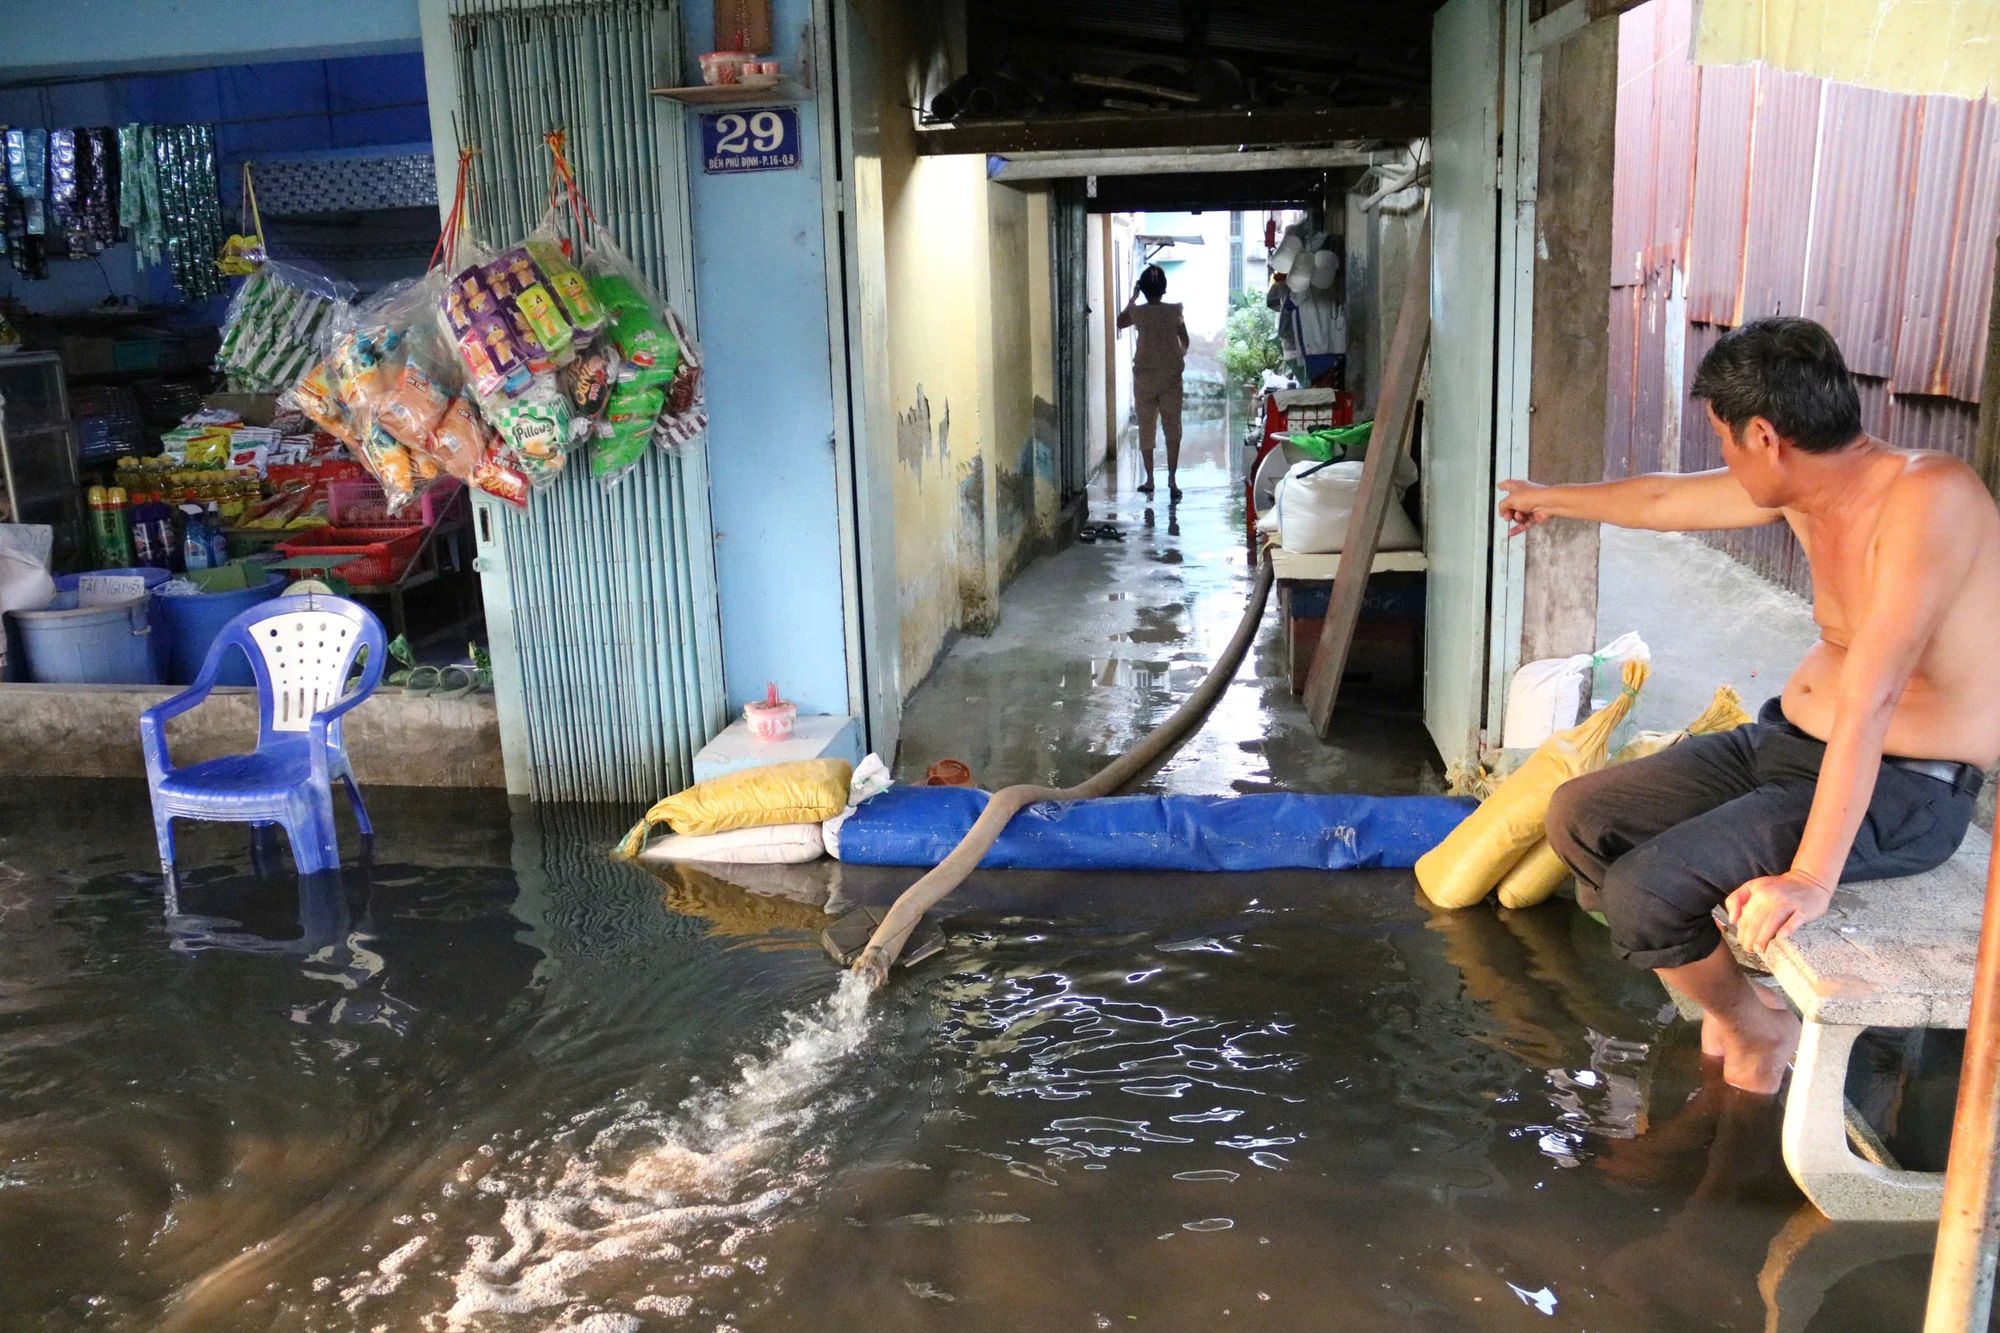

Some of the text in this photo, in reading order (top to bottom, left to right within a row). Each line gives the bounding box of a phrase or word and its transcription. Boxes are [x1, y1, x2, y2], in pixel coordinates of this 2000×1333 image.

[716, 111, 784, 153] 29
[708, 154, 724, 169] BẾN
[516, 424, 552, 441] Pillows
